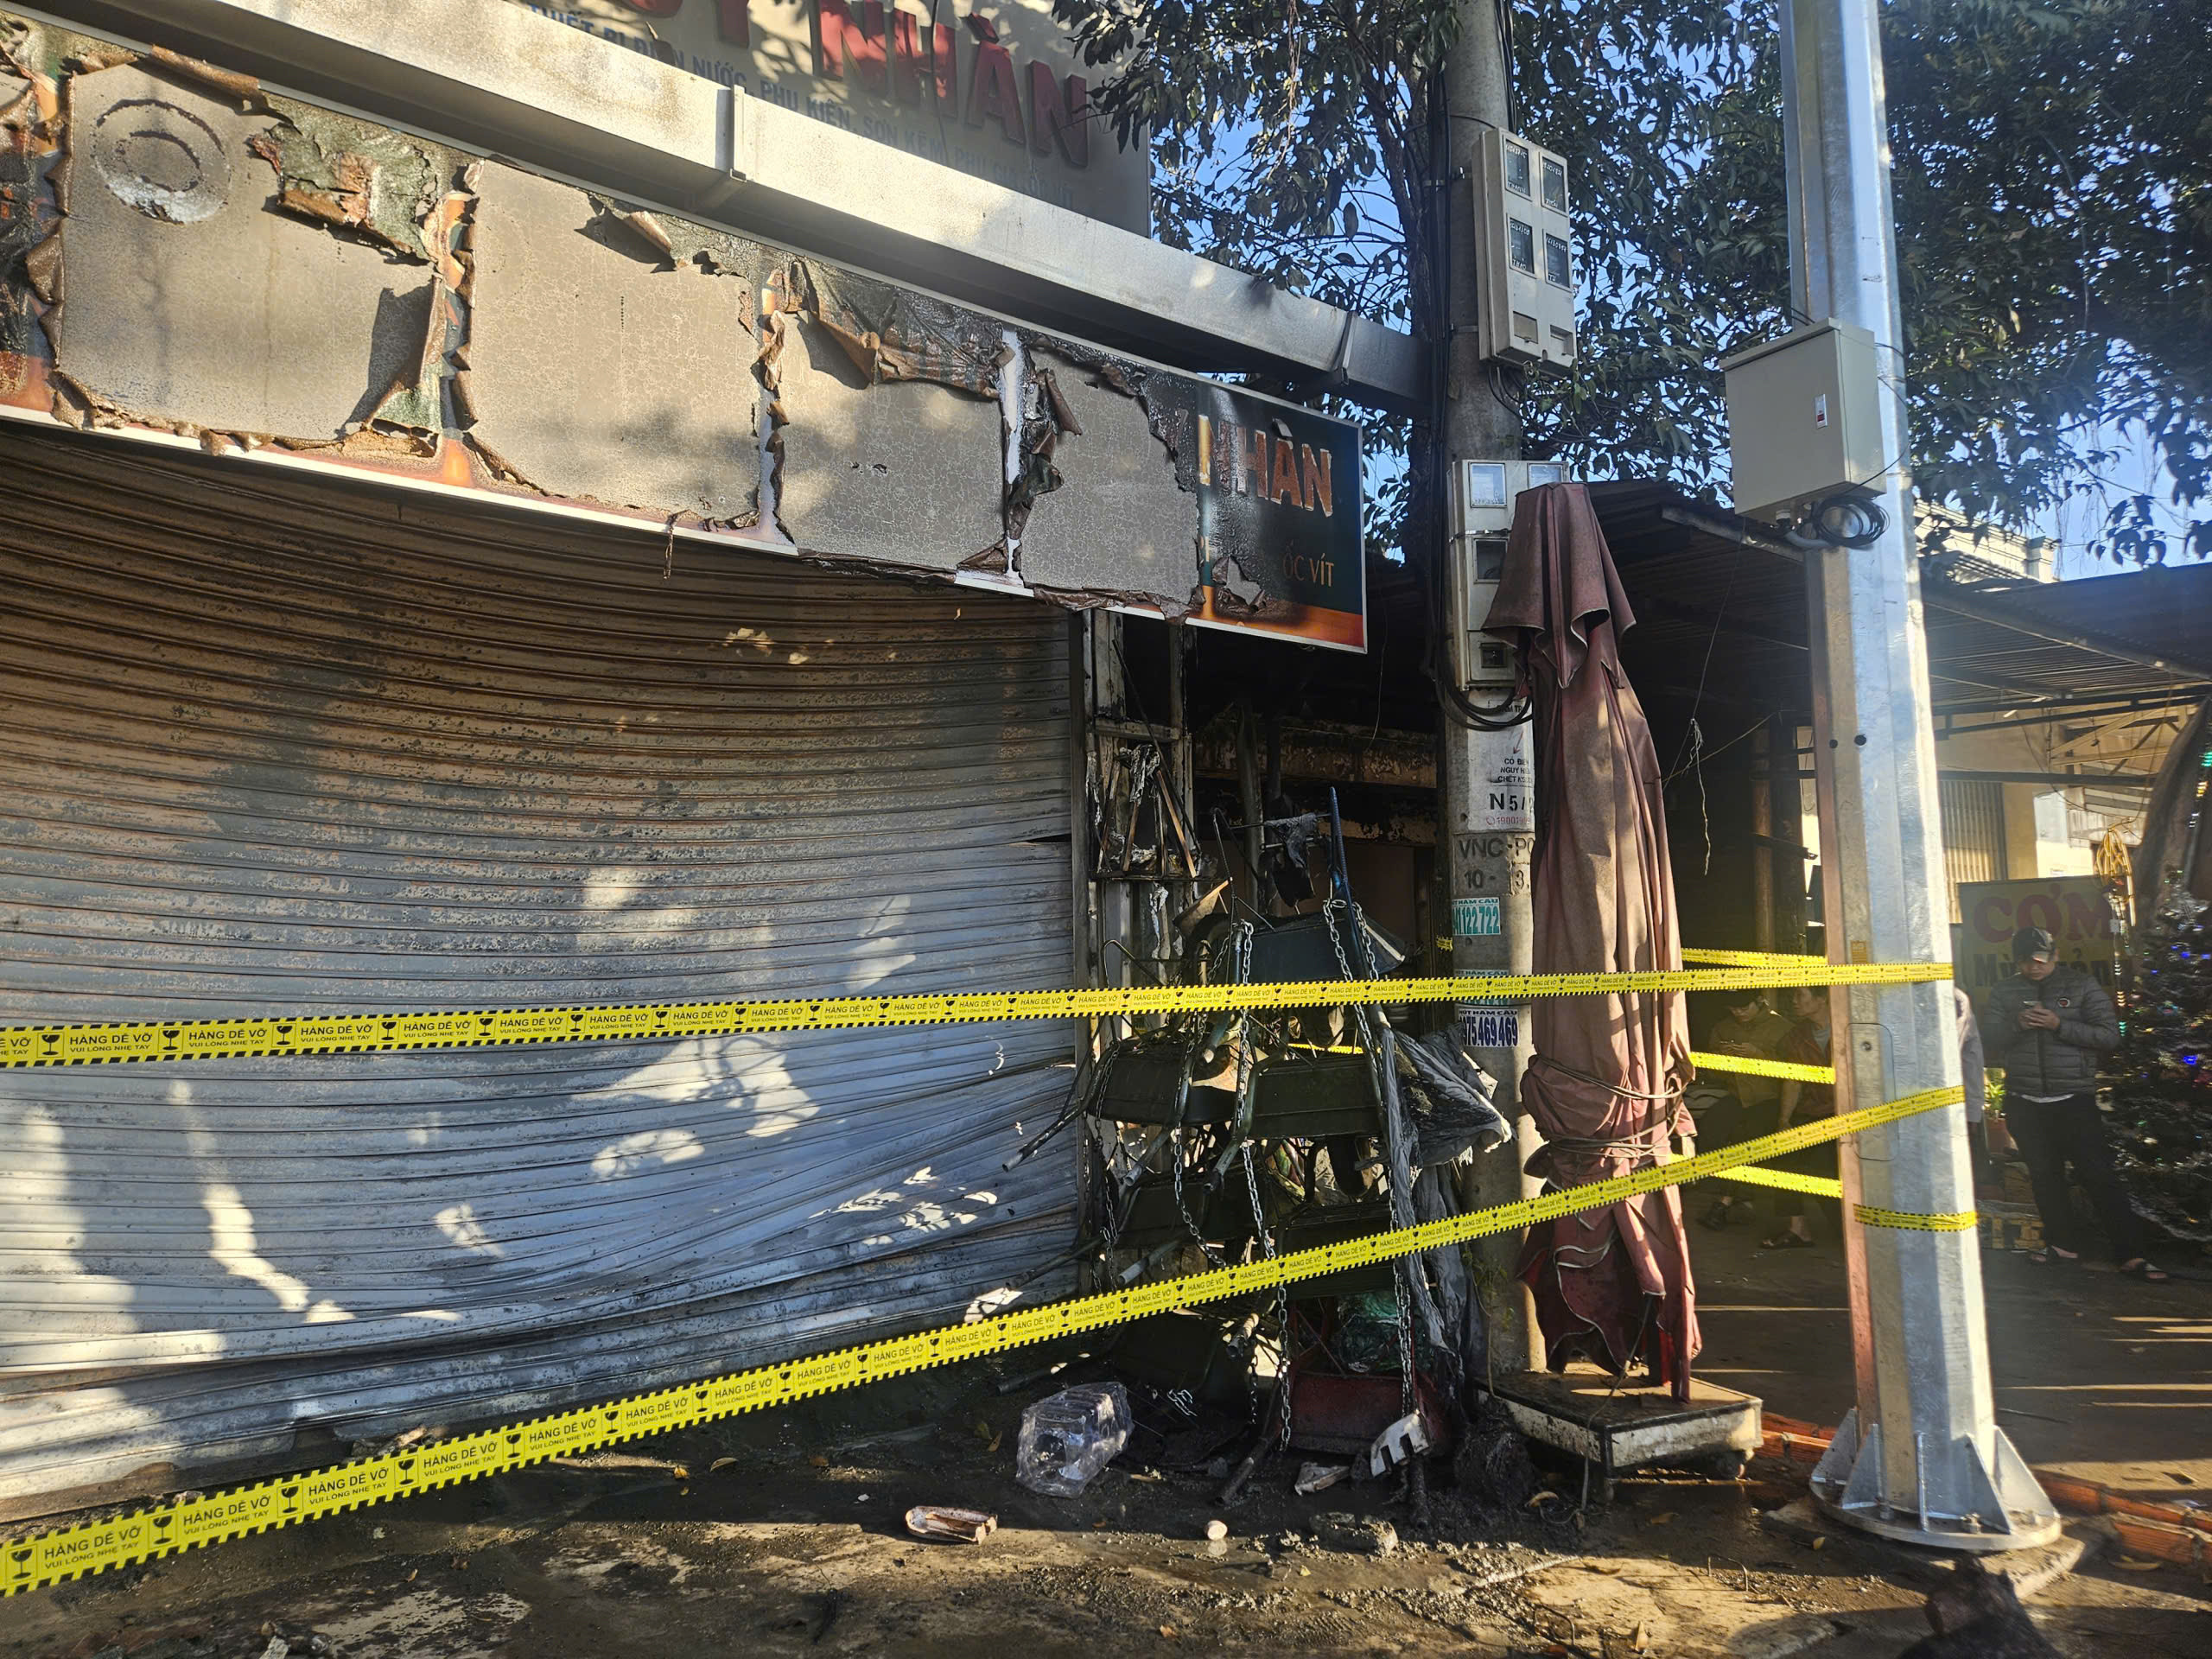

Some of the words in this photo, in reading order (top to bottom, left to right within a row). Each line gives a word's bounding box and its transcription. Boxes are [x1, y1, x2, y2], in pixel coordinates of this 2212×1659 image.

[807, 0, 1091, 168] NHÀN
[1309, 552, 1335, 588] VÍT
[1489, 792, 1505, 811] N
[69, 1034, 107, 1045] HÀNG
[132, 1033, 152, 1043] VỠ
[188, 1030, 225, 1040] HÀNG
[248, 1028, 267, 1038] VỠ
[183, 1506, 223, 1526] HÀNG
[250, 1495, 270, 1510] VỠ
[44, 1538, 89, 1560] HÀNG
[118, 1526, 141, 1542] VỠ
